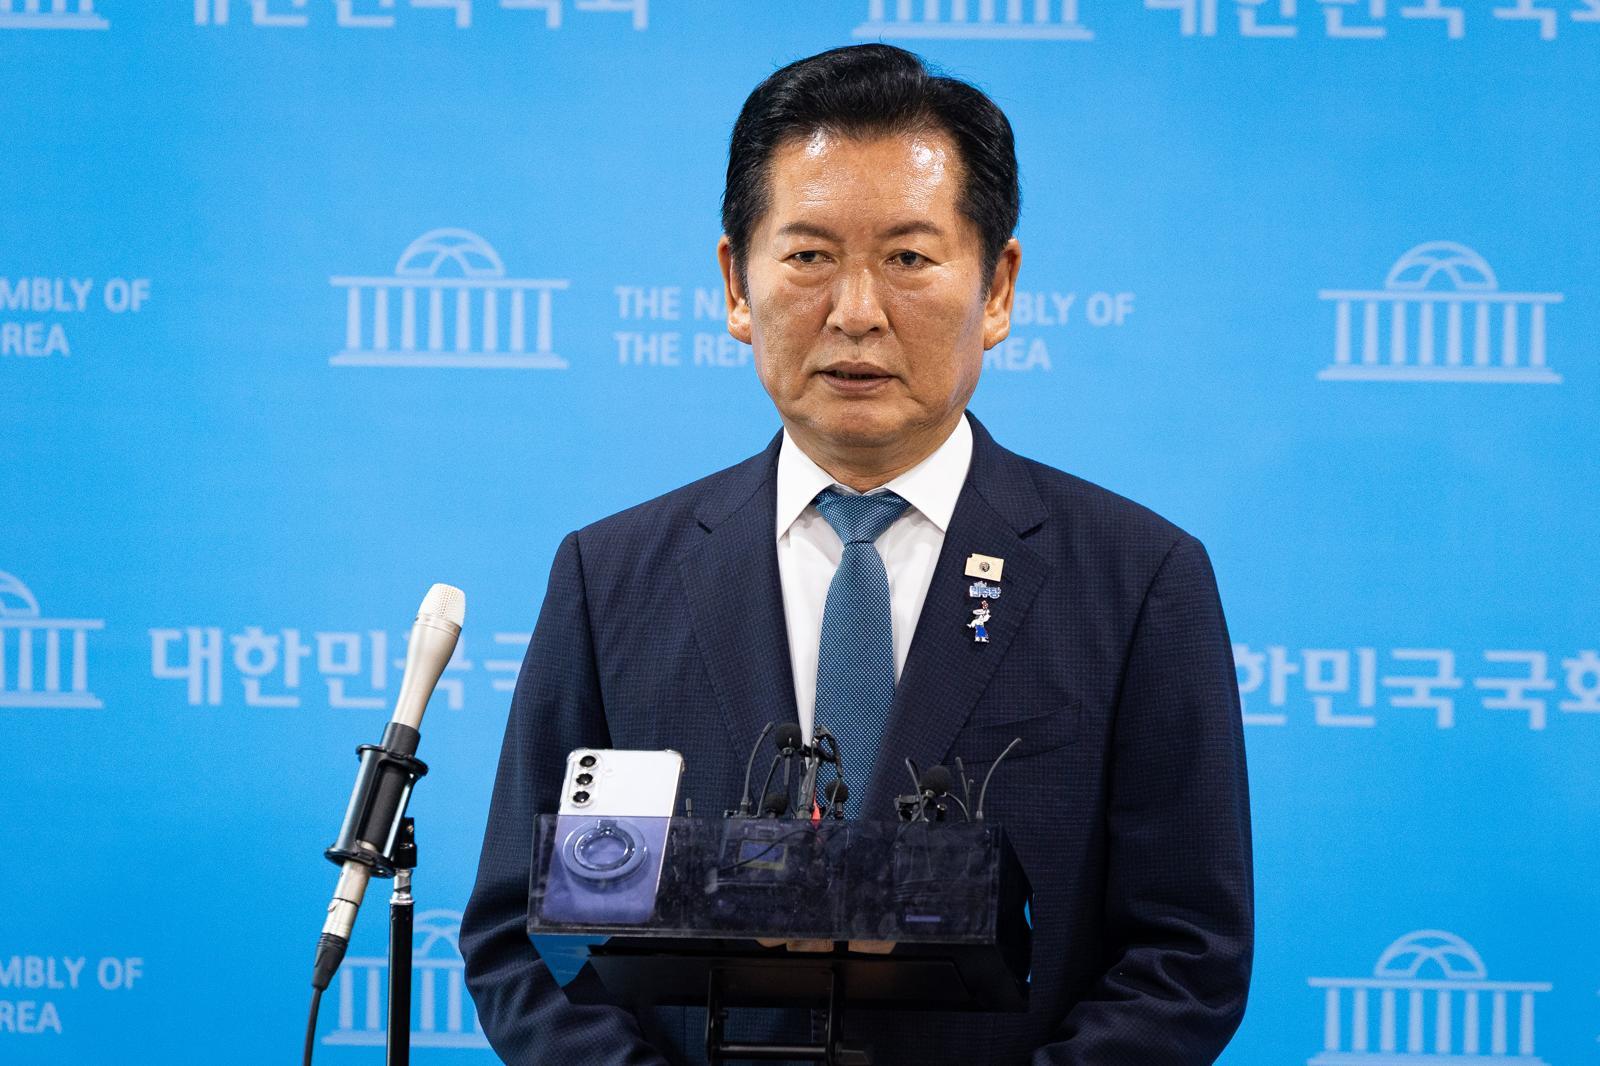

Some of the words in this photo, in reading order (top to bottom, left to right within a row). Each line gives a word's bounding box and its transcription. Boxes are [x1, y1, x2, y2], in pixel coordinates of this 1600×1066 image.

[104, 278, 150, 313] OF
[615, 285, 681, 321] THE
[1086, 291, 1135, 327] OF
[615, 331, 681, 367] THE
[97, 956, 143, 991] OF
